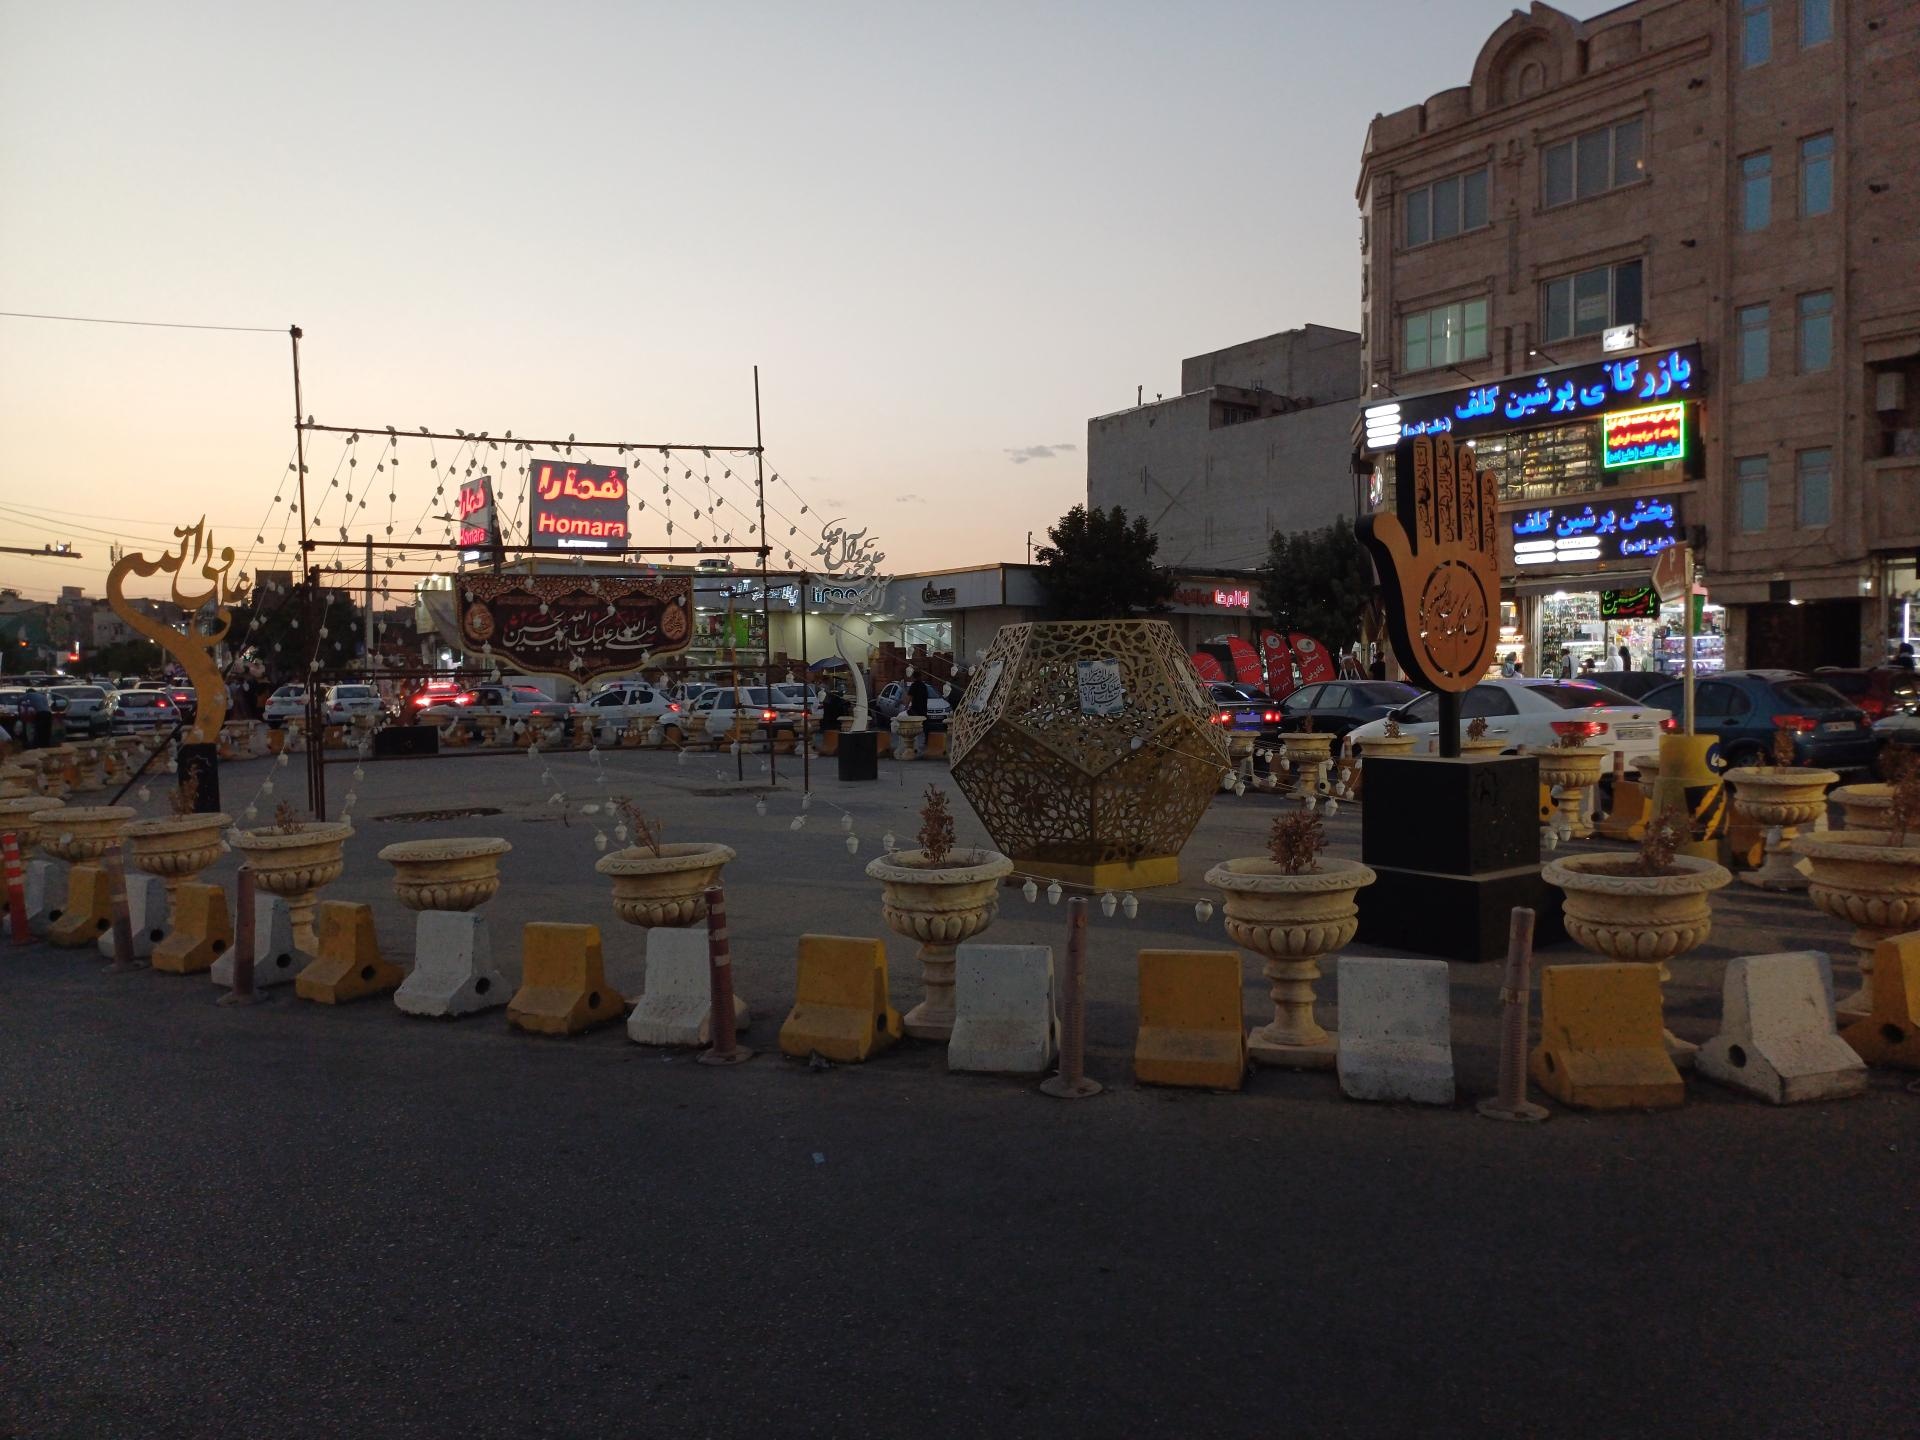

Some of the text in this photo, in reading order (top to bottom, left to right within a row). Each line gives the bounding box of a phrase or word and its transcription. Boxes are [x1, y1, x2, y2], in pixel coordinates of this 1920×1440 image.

[1455, 386, 1500, 419] گلف
[1505, 377, 1575, 419] پرشین
[538, 512, 626, 538] Homara
[1513, 498, 1675, 536] پخش پرشین گلف
